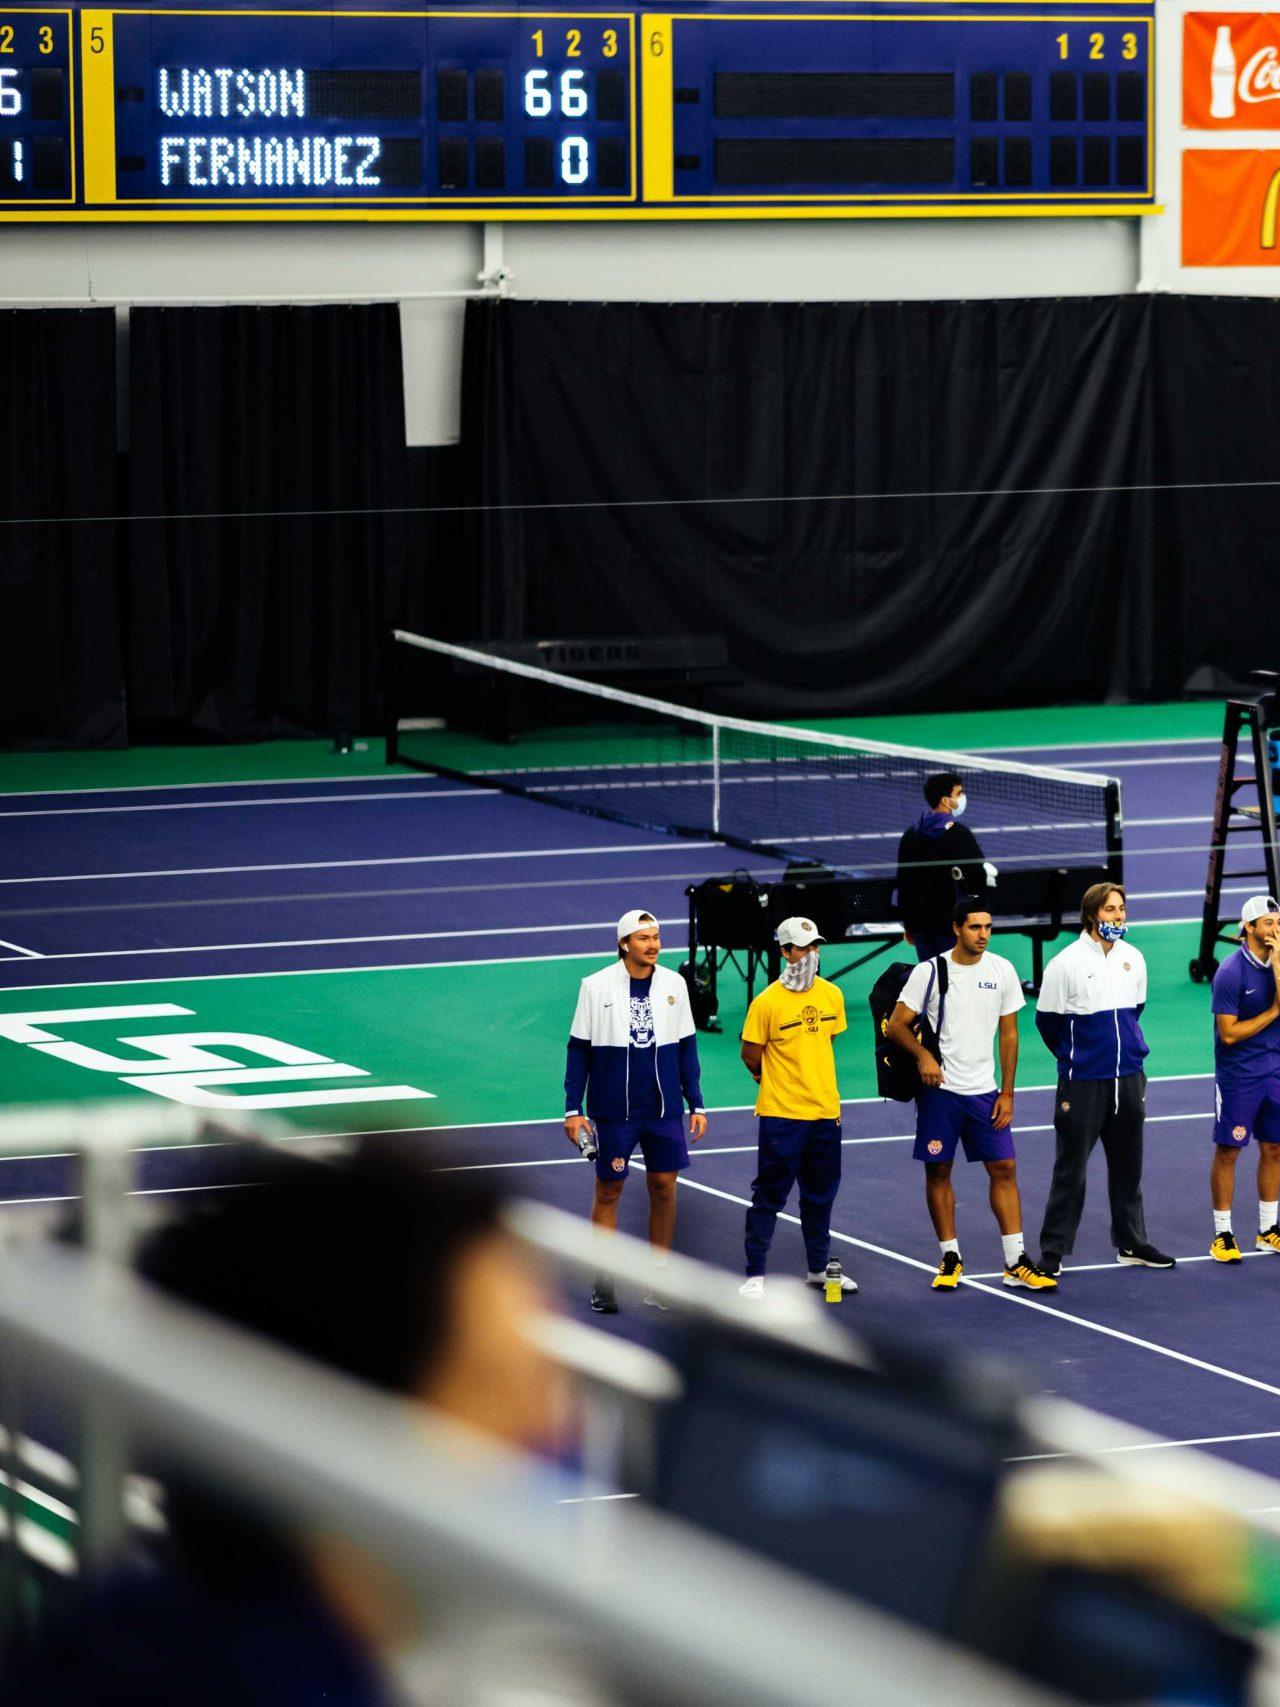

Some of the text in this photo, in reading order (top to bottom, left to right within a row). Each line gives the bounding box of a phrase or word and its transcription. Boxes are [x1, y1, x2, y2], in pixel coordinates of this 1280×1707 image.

[0, 25, 54, 54] 2 3
[89, 27, 105, 53] 5
[532, 29, 618, 58] 1 2 3
[649, 32, 665, 58] 6
[1056, 33, 1138, 60] 1 2 3
[0, 67, 22, 116] 6
[158, 67, 305, 118] WATSON
[13, 140, 23, 182] 1
[160, 136, 381, 186] FERNANDEZ
[561, 136, 588, 184] 0
[978, 981, 997, 990] LSU
[0, 1003, 437, 1110] LSU
